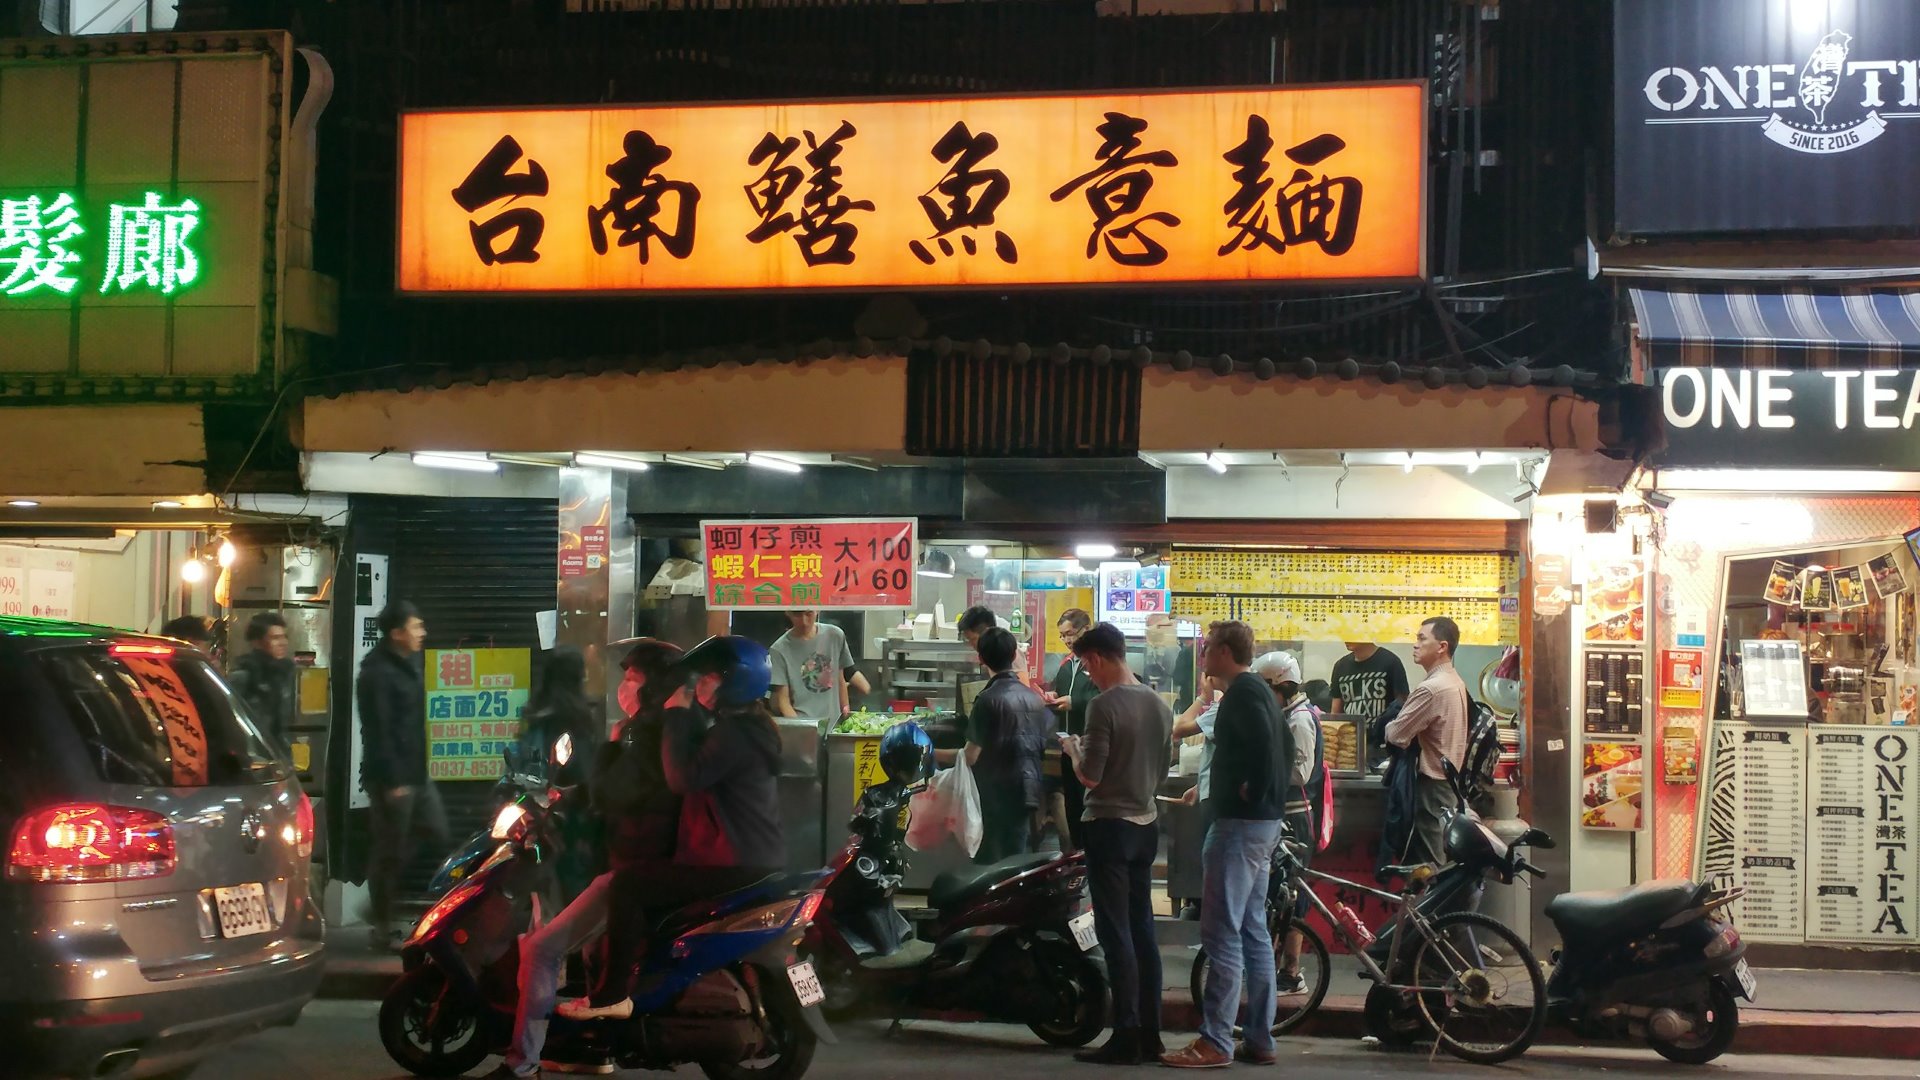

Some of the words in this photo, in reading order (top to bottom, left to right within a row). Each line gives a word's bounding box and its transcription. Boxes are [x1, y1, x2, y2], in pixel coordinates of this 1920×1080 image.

[1643, 64, 1796, 112] ONE
[1789, 132, 1825, 150] SINCE
[1828, 130, 1860, 150] 2016
[452, 111, 1364, 267] 台南鱔魚意麵
[0, 191, 200, 295] 髮廊
[1663, 367, 1796, 429] ONE
[710, 525, 823, 551] 蚵仔煎
[834, 537, 860, 563] 大
[867, 537, 911, 562] 100
[712, 553, 824, 579] 蝦仁煎
[833, 566, 859, 592] 小
[872, 568, 908, 591] 60
[714, 582, 822, 606] 綜合煎
[439, 653, 474, 687] 租
[1340, 679, 1387, 702] BLKS
[1873, 734, 1909, 822] ONE
[1875, 825, 1907, 840] 灣茶
[1871, 842, 1909, 935] TEA
